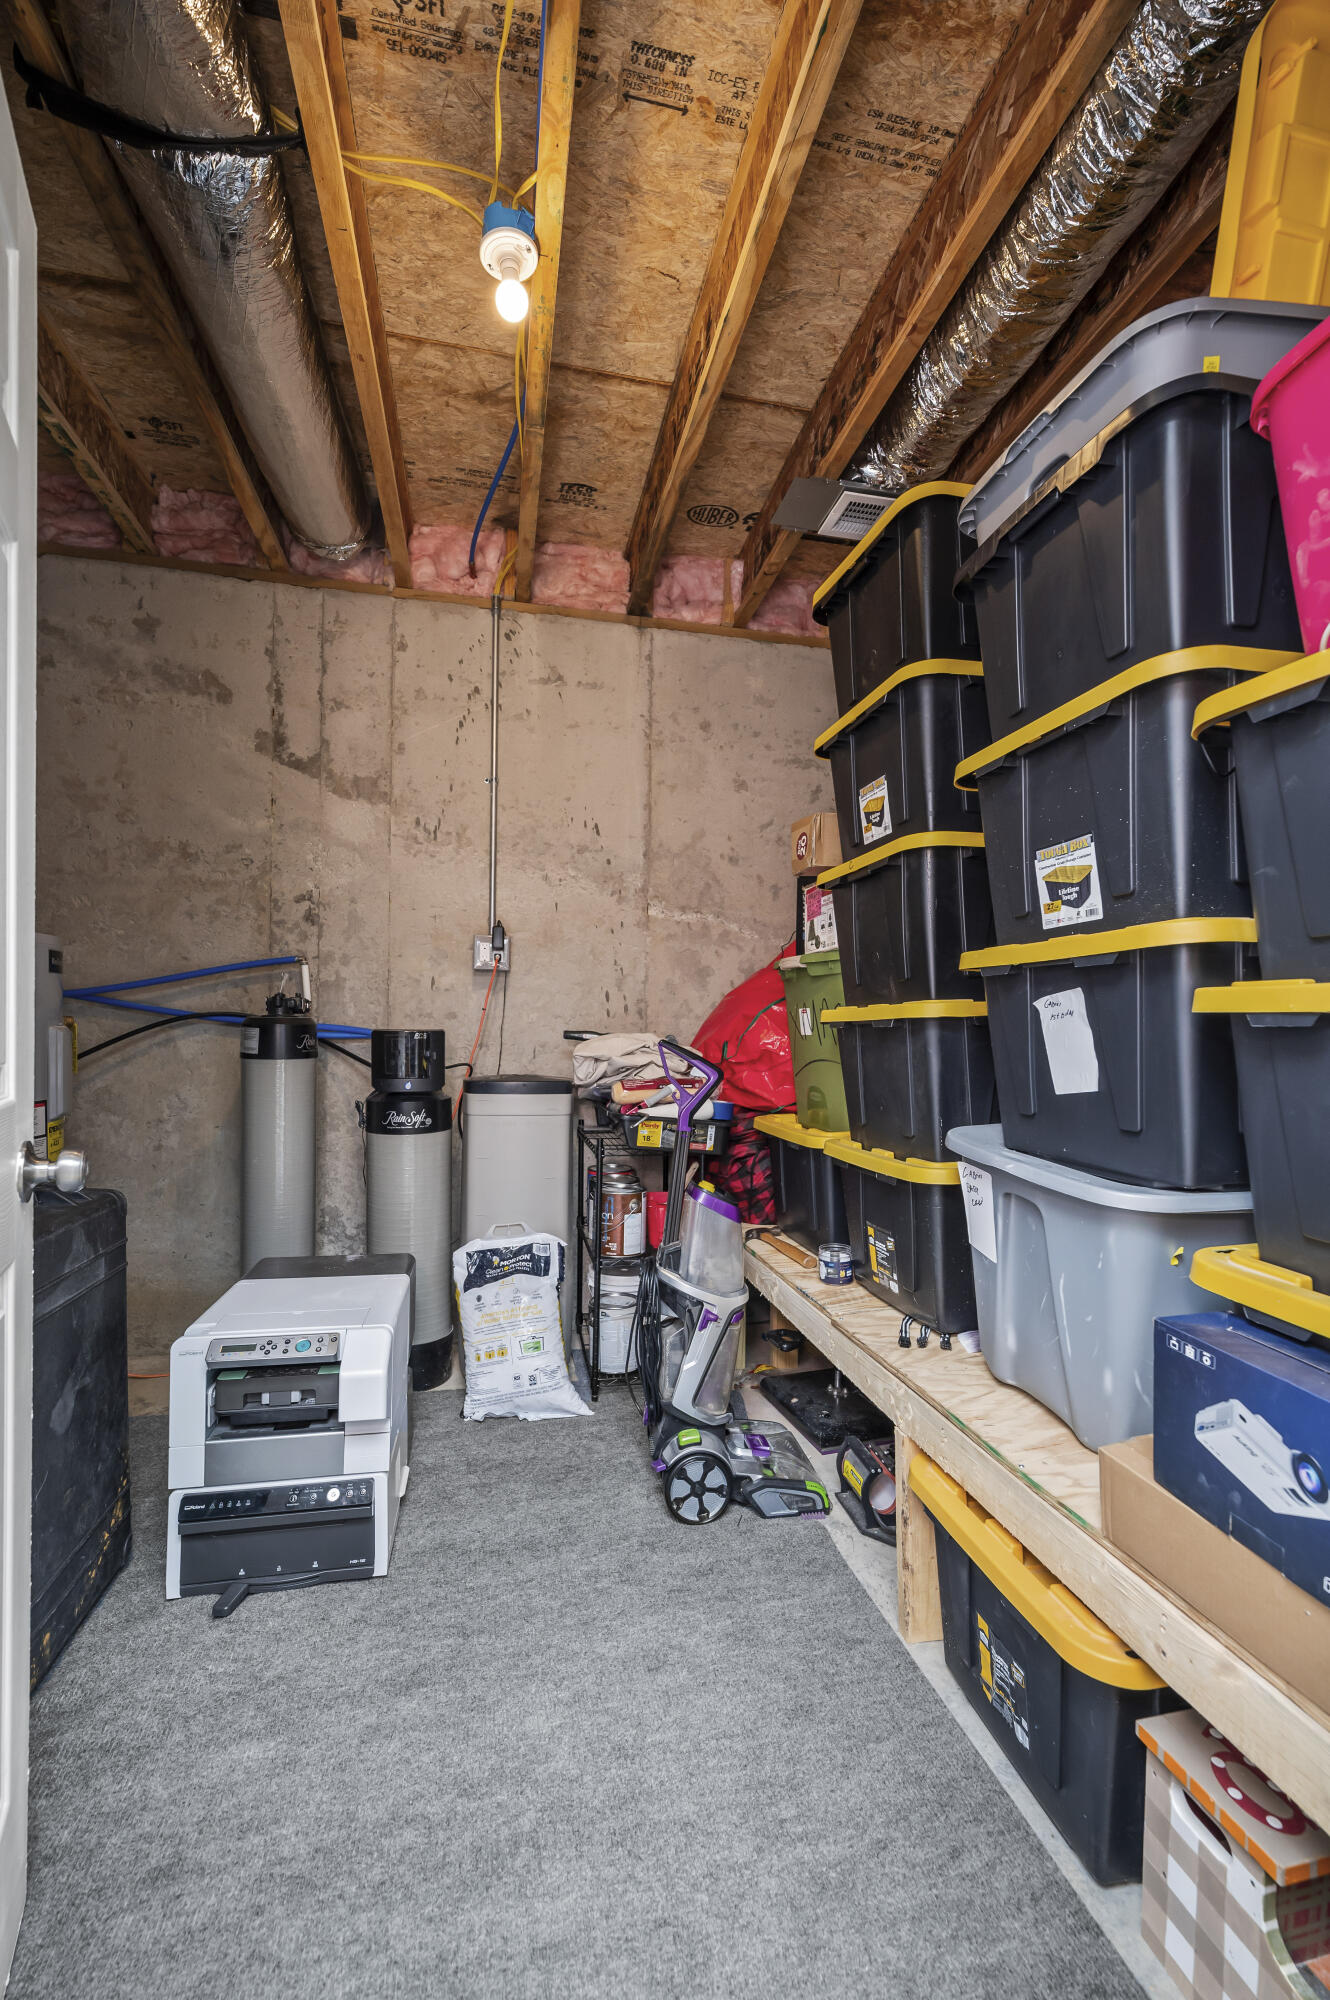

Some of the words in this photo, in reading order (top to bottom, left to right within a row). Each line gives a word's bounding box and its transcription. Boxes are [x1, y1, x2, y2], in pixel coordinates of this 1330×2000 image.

[371, 7, 417, 27] Certified
[630, 40, 696, 67] THICKNESS
[707, 69, 748, 90] ICC-ES
[622, 78, 643, 91] THIS
[646, 85, 694, 105] DIRECTION
[715, 115, 735, 128] ESTE
[692, 507, 735, 525] HUBER
[500, 1253, 532, 1267] MORTON
